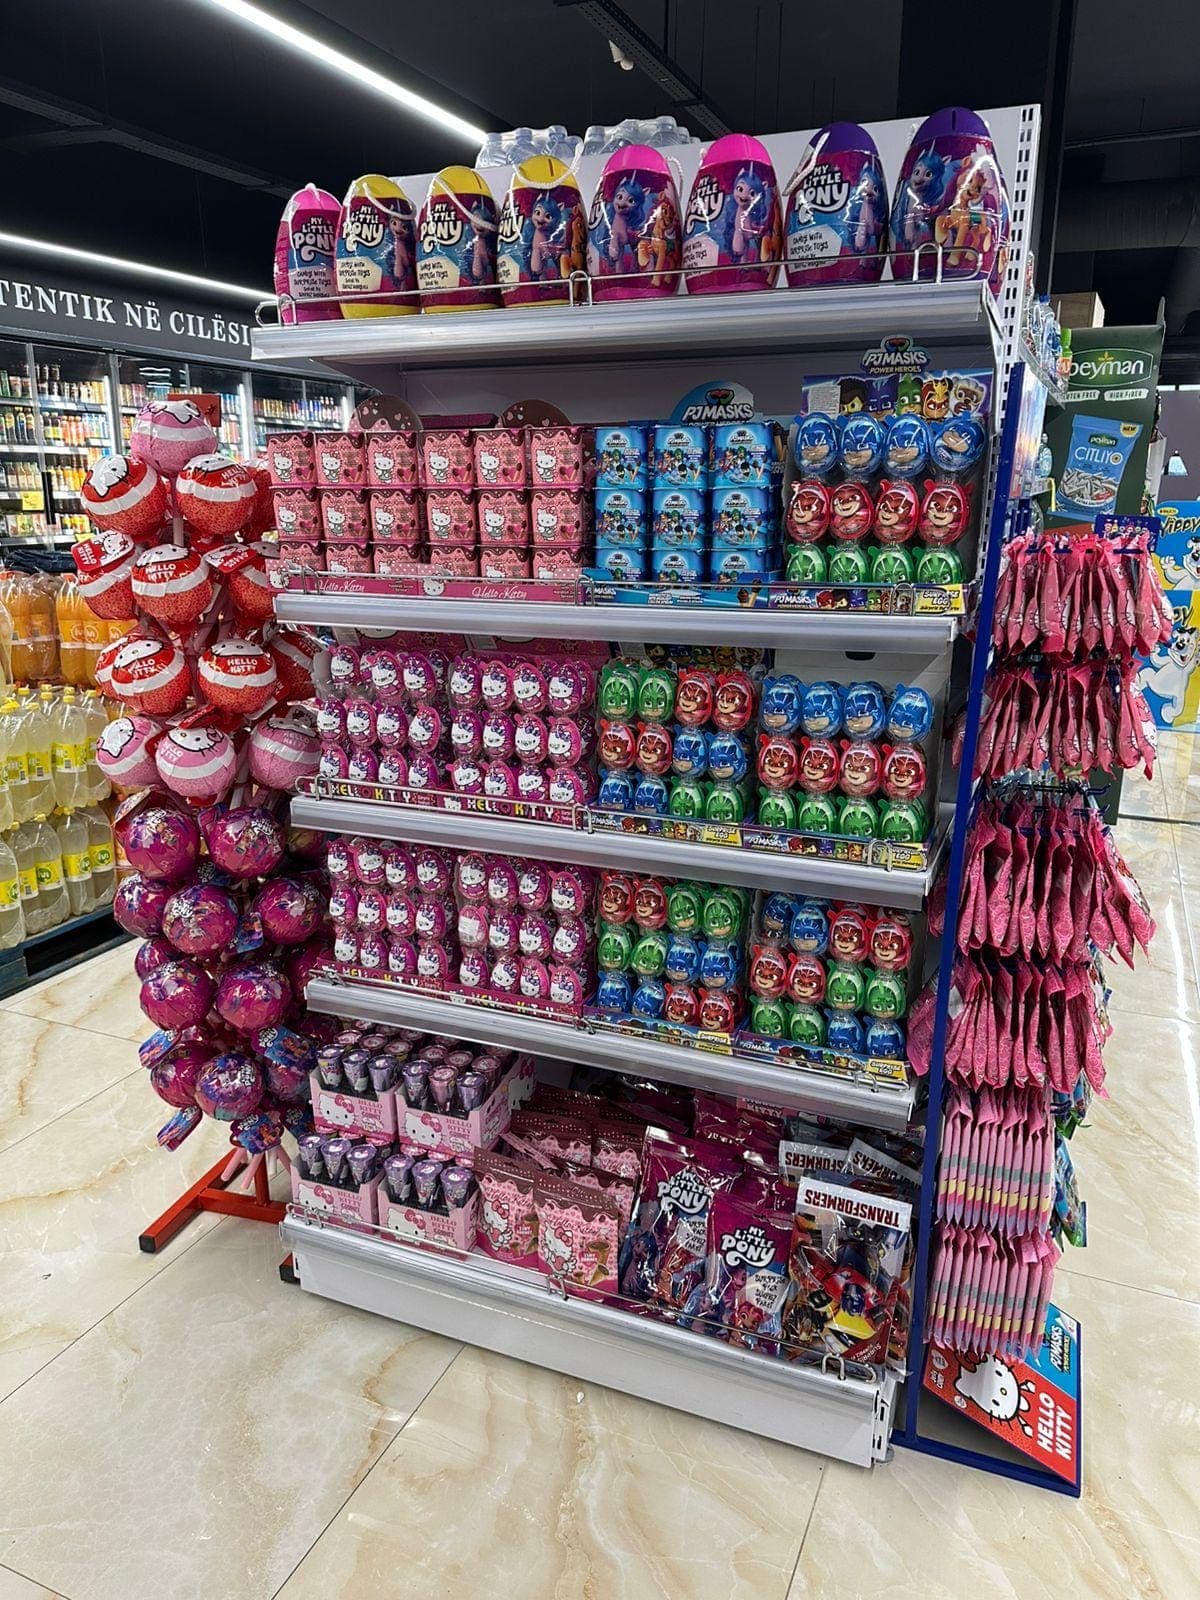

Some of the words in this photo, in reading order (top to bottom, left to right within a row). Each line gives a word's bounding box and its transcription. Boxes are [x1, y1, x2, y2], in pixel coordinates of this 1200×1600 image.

[814, 165, 829, 176] MY
[795, 183, 849, 224] PONY
[125, 301, 162, 332] NË
[869, 367, 894, 375] POWER
[84, 543, 97, 565] HELLO
[471, 586, 499, 598] Hello
[499, 586, 527, 600] Kitty
[227, 658, 258, 666] HELLO
[785, 1151, 845, 1172] SFORMERS
[657, 1181, 707, 1214] PONY
[804, 1189, 900, 1227] TRANSFORMERS
[749, 1225, 765, 1236] MY
[721, 1234, 776, 1267] PONY
[1037, 1392, 1056, 1453] HELLO
[1055, 1404, 1073, 1462] KITTY
